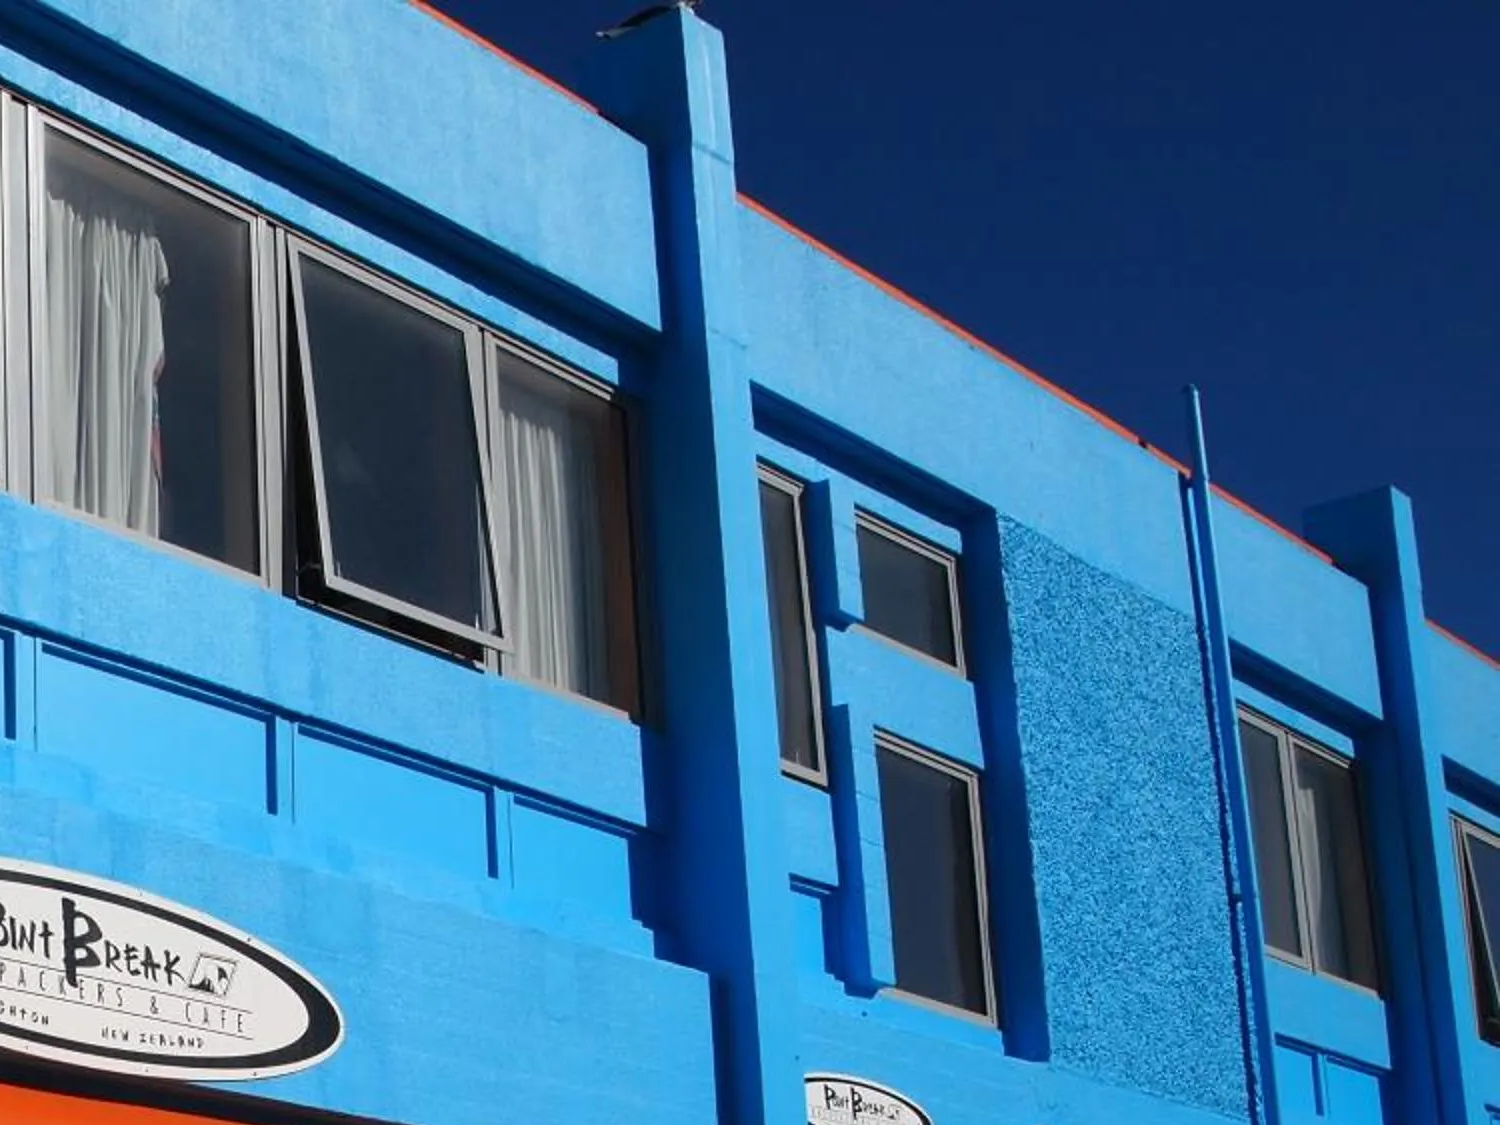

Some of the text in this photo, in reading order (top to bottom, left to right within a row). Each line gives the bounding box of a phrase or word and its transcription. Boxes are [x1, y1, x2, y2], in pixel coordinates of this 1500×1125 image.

[62, 897, 186, 988] BREAK
[148, 996, 159, 1015] &
[101, 1027, 205, 1049] NEW ZEALAND
